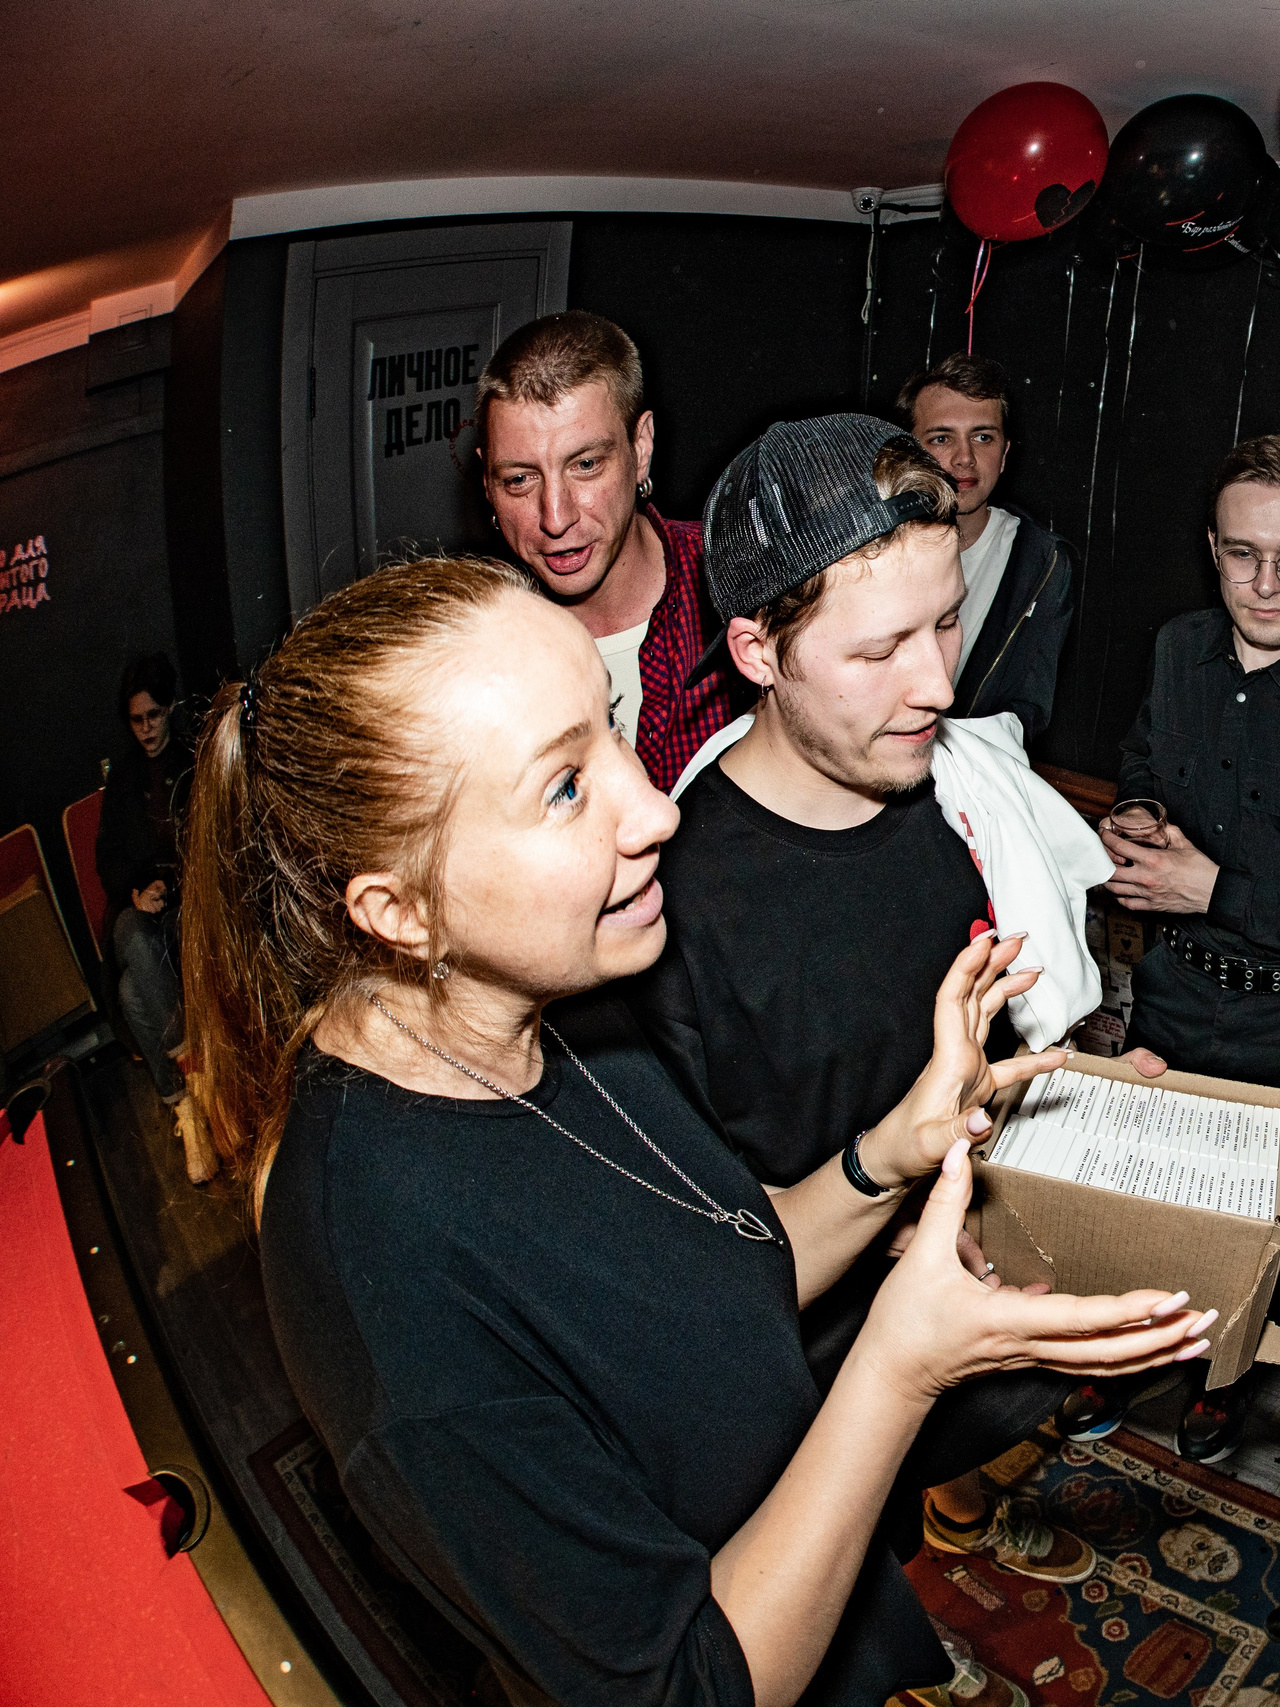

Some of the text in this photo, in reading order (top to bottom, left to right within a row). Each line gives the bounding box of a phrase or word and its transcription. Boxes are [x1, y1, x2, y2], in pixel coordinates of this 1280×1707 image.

[368, 344, 479, 401] ЛИЧНОЕ
[384, 398, 461, 458] ДЕЛО
[9, 535, 48, 566] ДЛЯ
